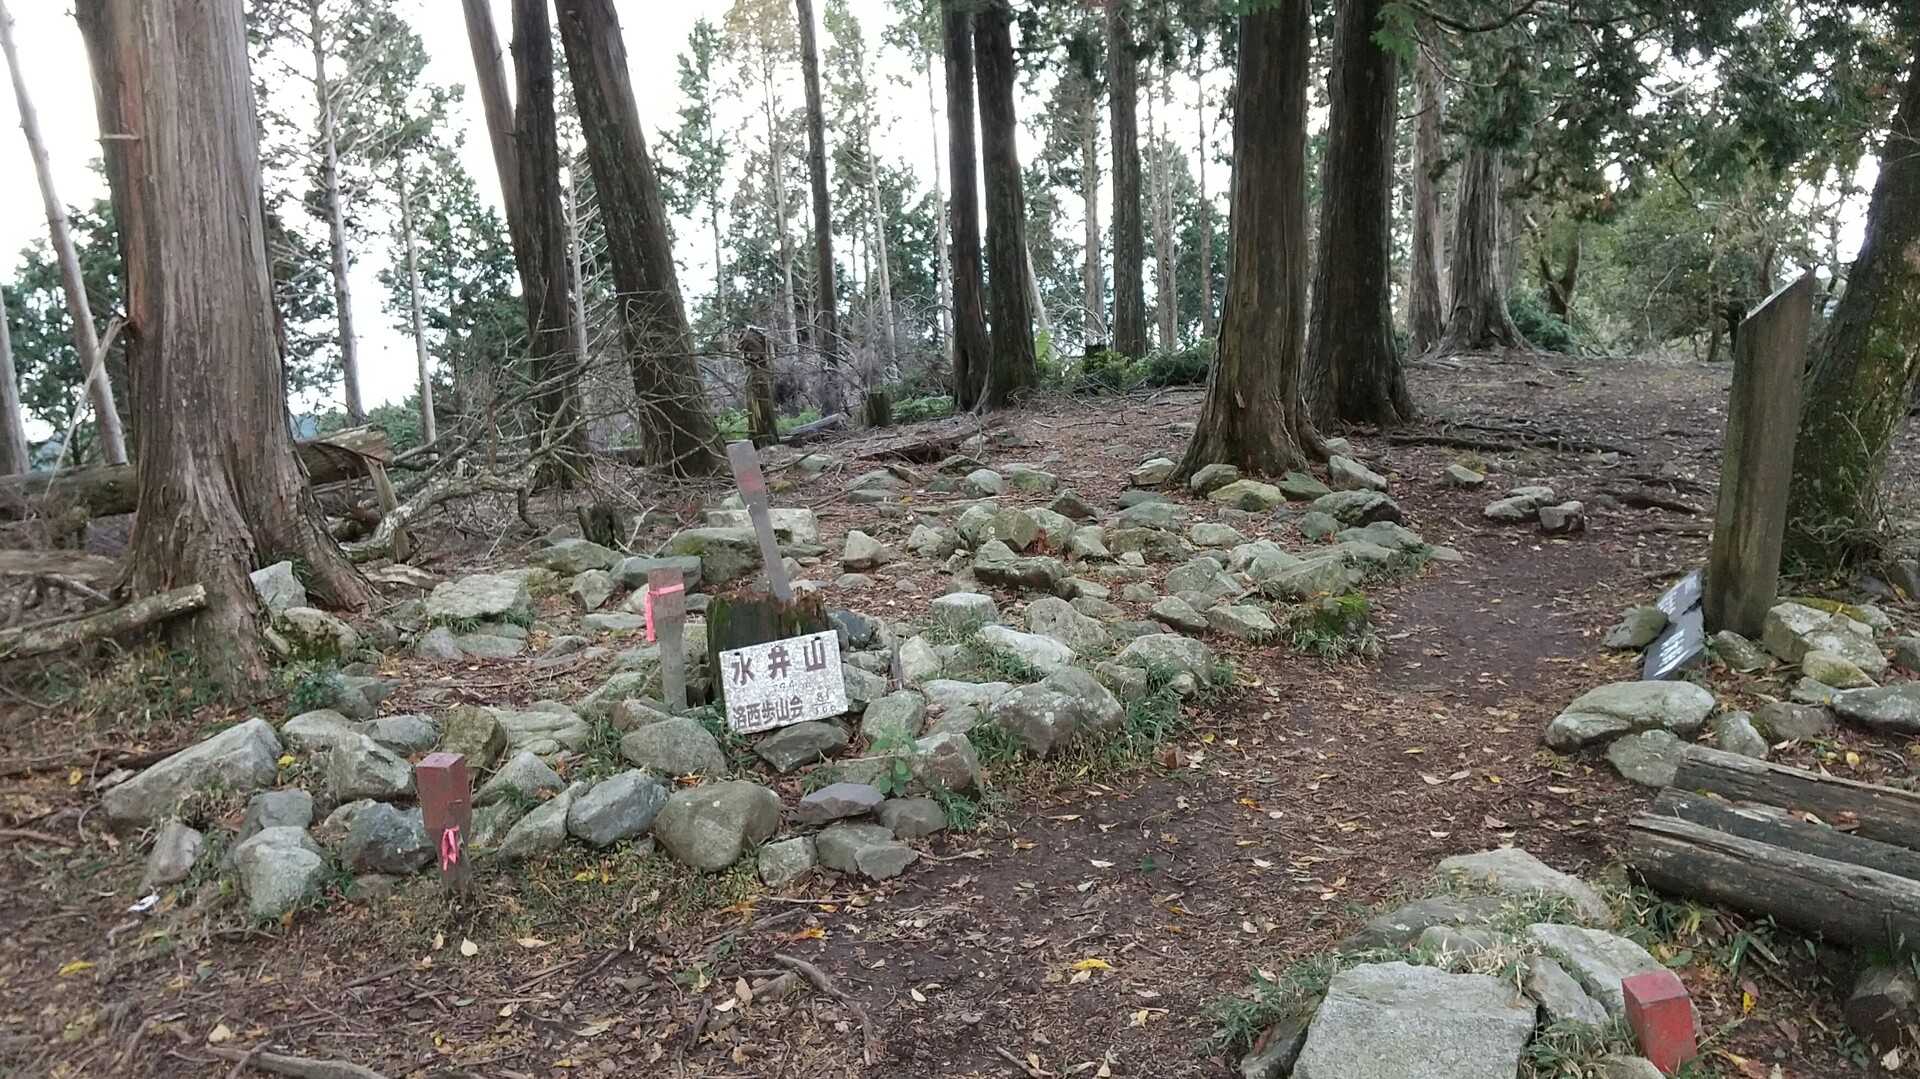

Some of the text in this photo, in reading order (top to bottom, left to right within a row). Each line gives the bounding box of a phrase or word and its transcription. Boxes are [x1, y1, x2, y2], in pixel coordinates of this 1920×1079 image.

[731, 639, 826, 686] 水井山
[732, 695, 804, 729] 洛西歩山会
